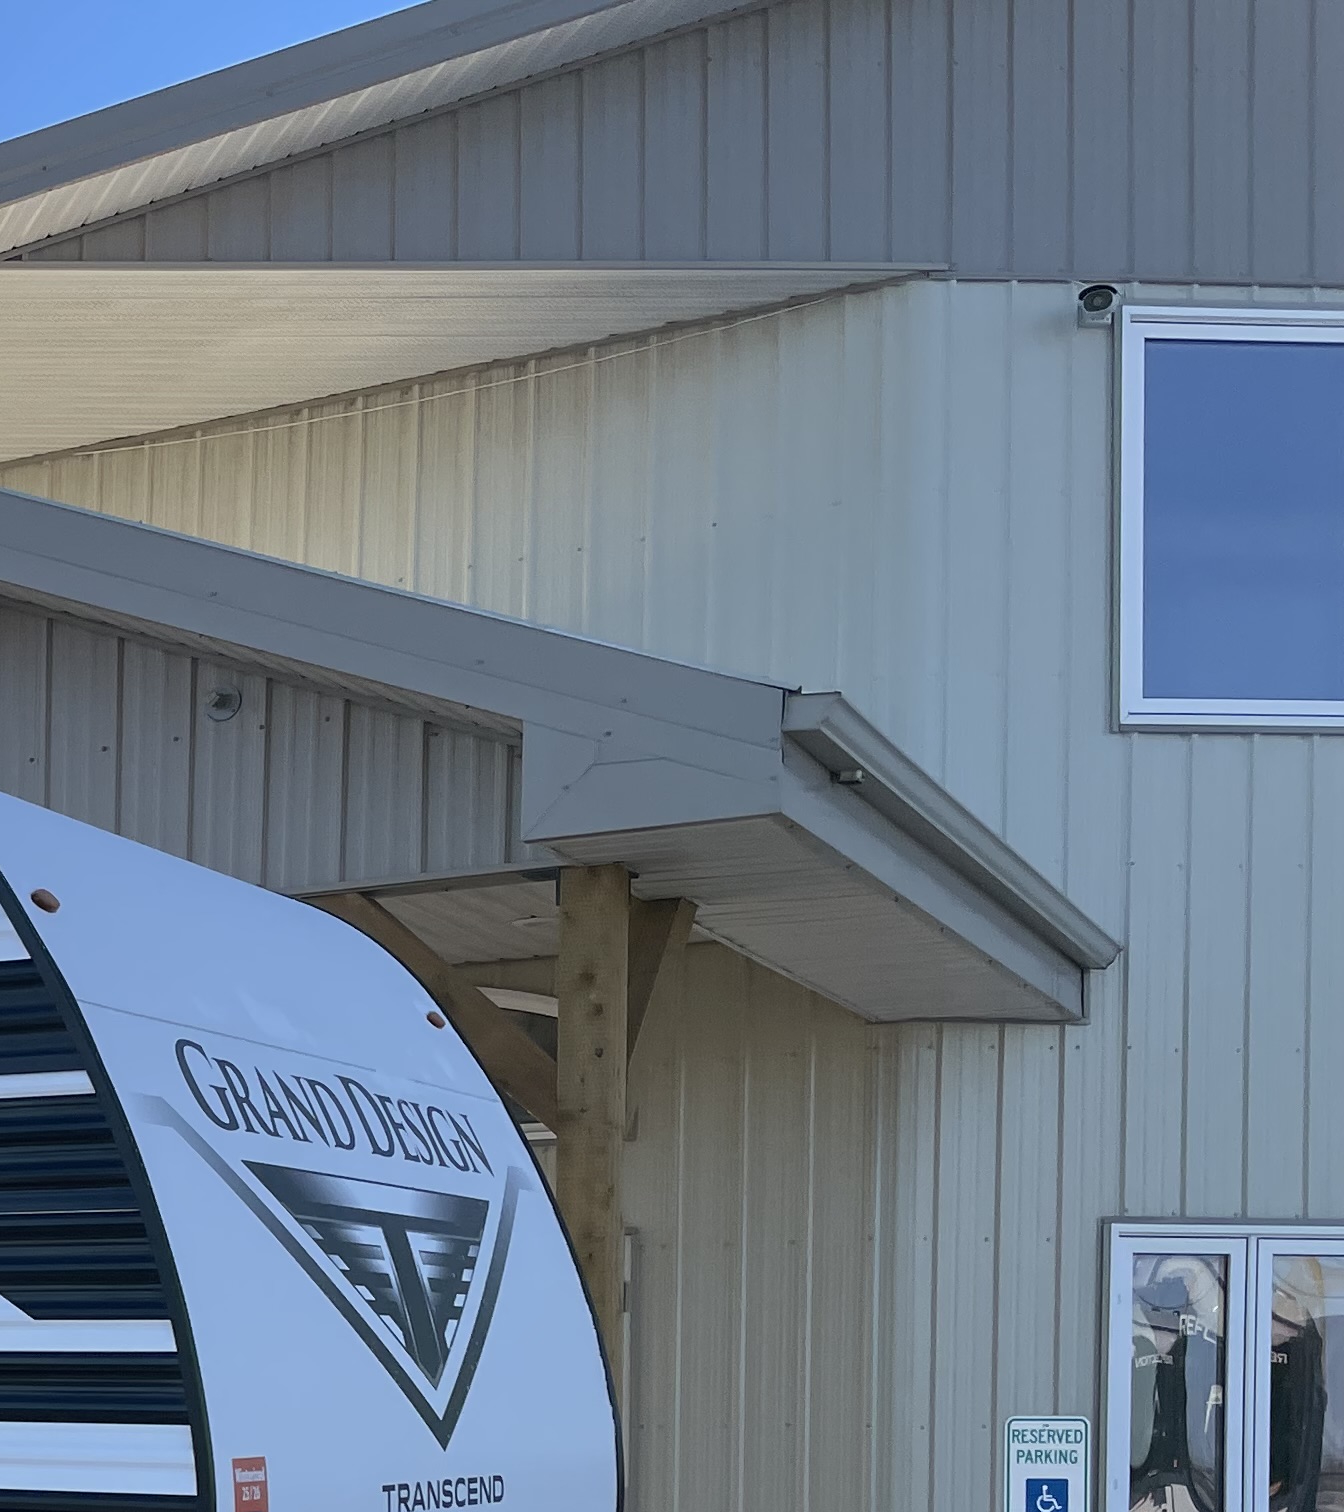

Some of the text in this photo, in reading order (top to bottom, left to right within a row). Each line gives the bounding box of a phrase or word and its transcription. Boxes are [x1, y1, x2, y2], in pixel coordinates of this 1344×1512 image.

[175, 1038, 494, 1177] GRAND DESIGN
[1011, 1429, 1084, 1444] RESERVED
[1016, 1449, 1079, 1465] PARKING
